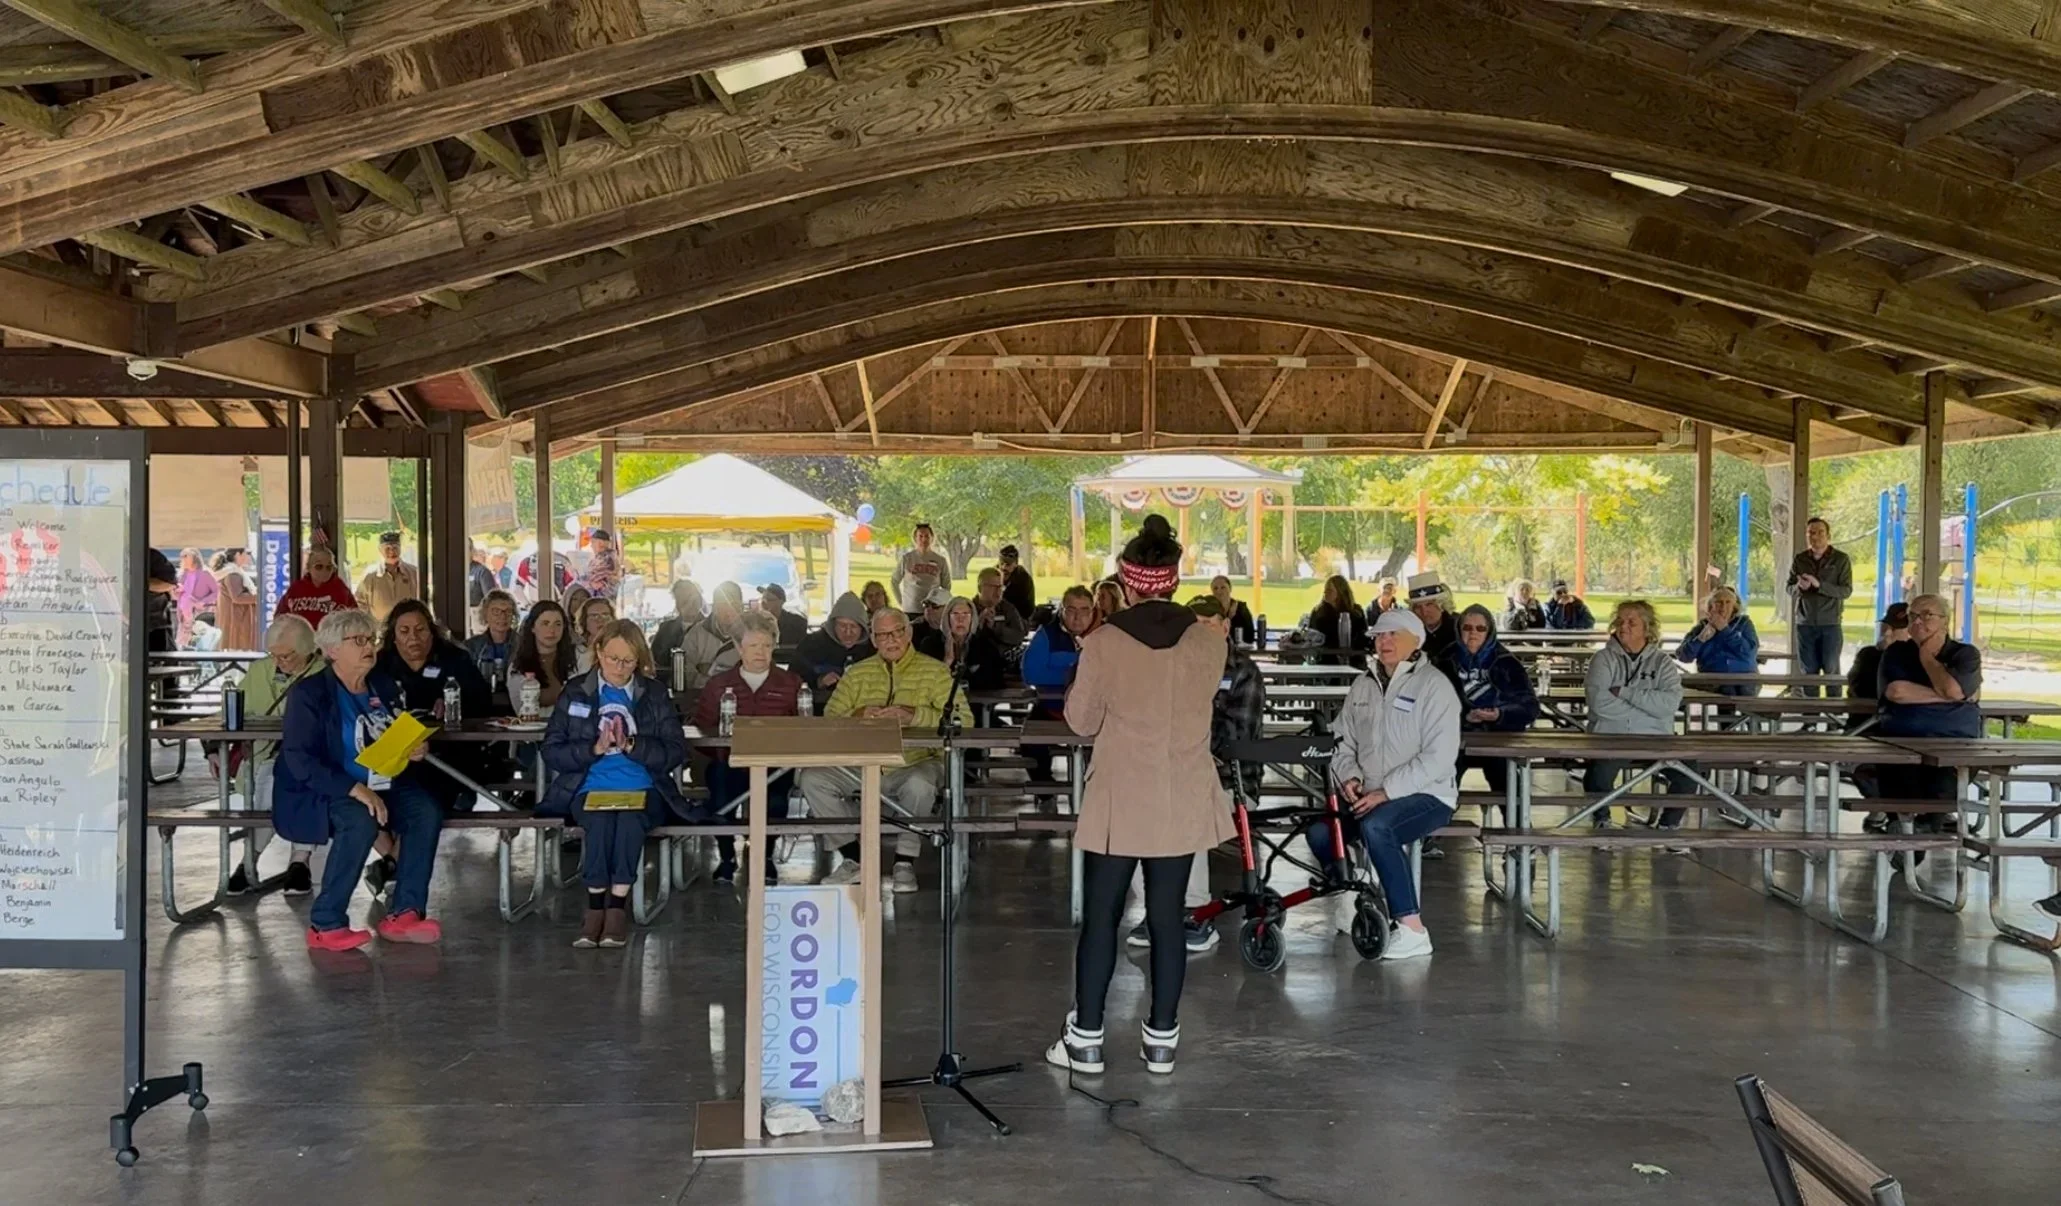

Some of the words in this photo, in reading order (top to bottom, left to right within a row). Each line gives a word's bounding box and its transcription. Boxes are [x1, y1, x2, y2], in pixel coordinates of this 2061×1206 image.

[0, 464, 110, 506] chedule
[45, 629, 73, 641] David
[9, 660, 43, 675] Chris
[49, 662, 88, 679] Taylor
[16, 678, 76, 693] McNamara
[23, 697, 64, 711] Garcia
[3, 738, 31, 750] State
[34, 736, 64, 750] Sarah
[18, 773, 61, 791] Angulo
[15, 787, 57, 807] Ripley
[6, 895, 51, 912] Benjamin
[3, 911, 36, 928] Berge
[763, 903, 781, 944] FOR
[790, 900, 819, 1089] GORDON
[761, 951, 780, 1091] WISCONSIN
